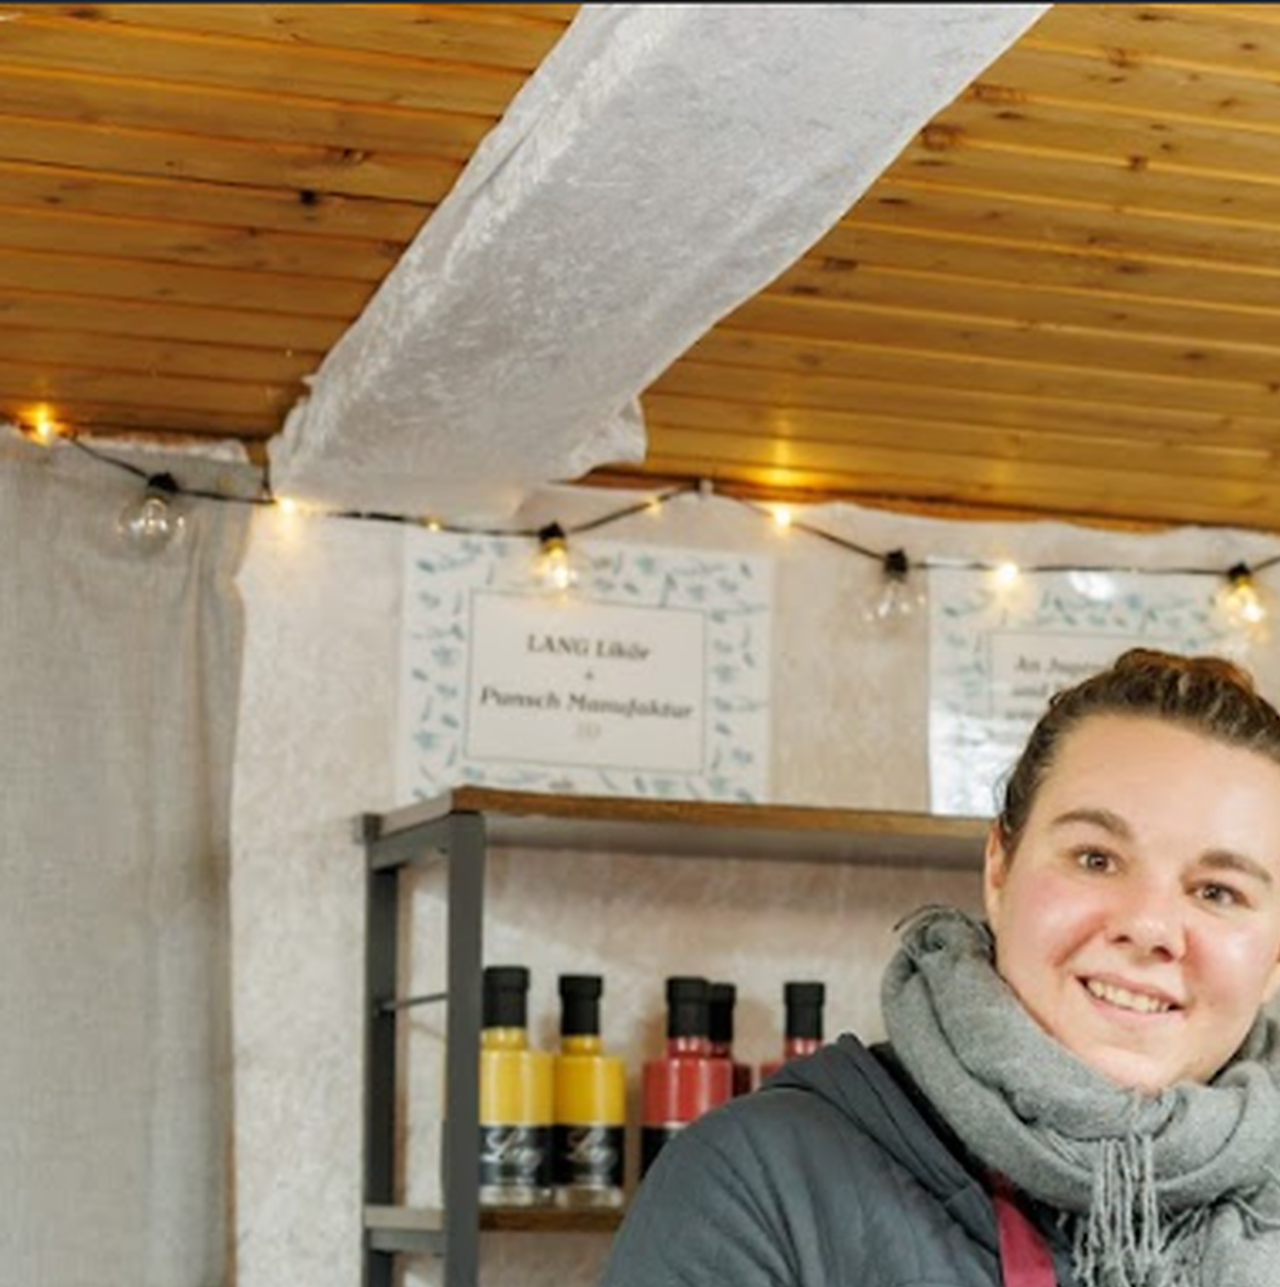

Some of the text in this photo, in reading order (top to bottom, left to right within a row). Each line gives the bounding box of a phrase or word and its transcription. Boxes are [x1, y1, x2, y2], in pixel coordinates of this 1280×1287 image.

[527, 634, 652, 661] LANG Likör
[480, 686, 694, 720] Punsch Manufaktur
